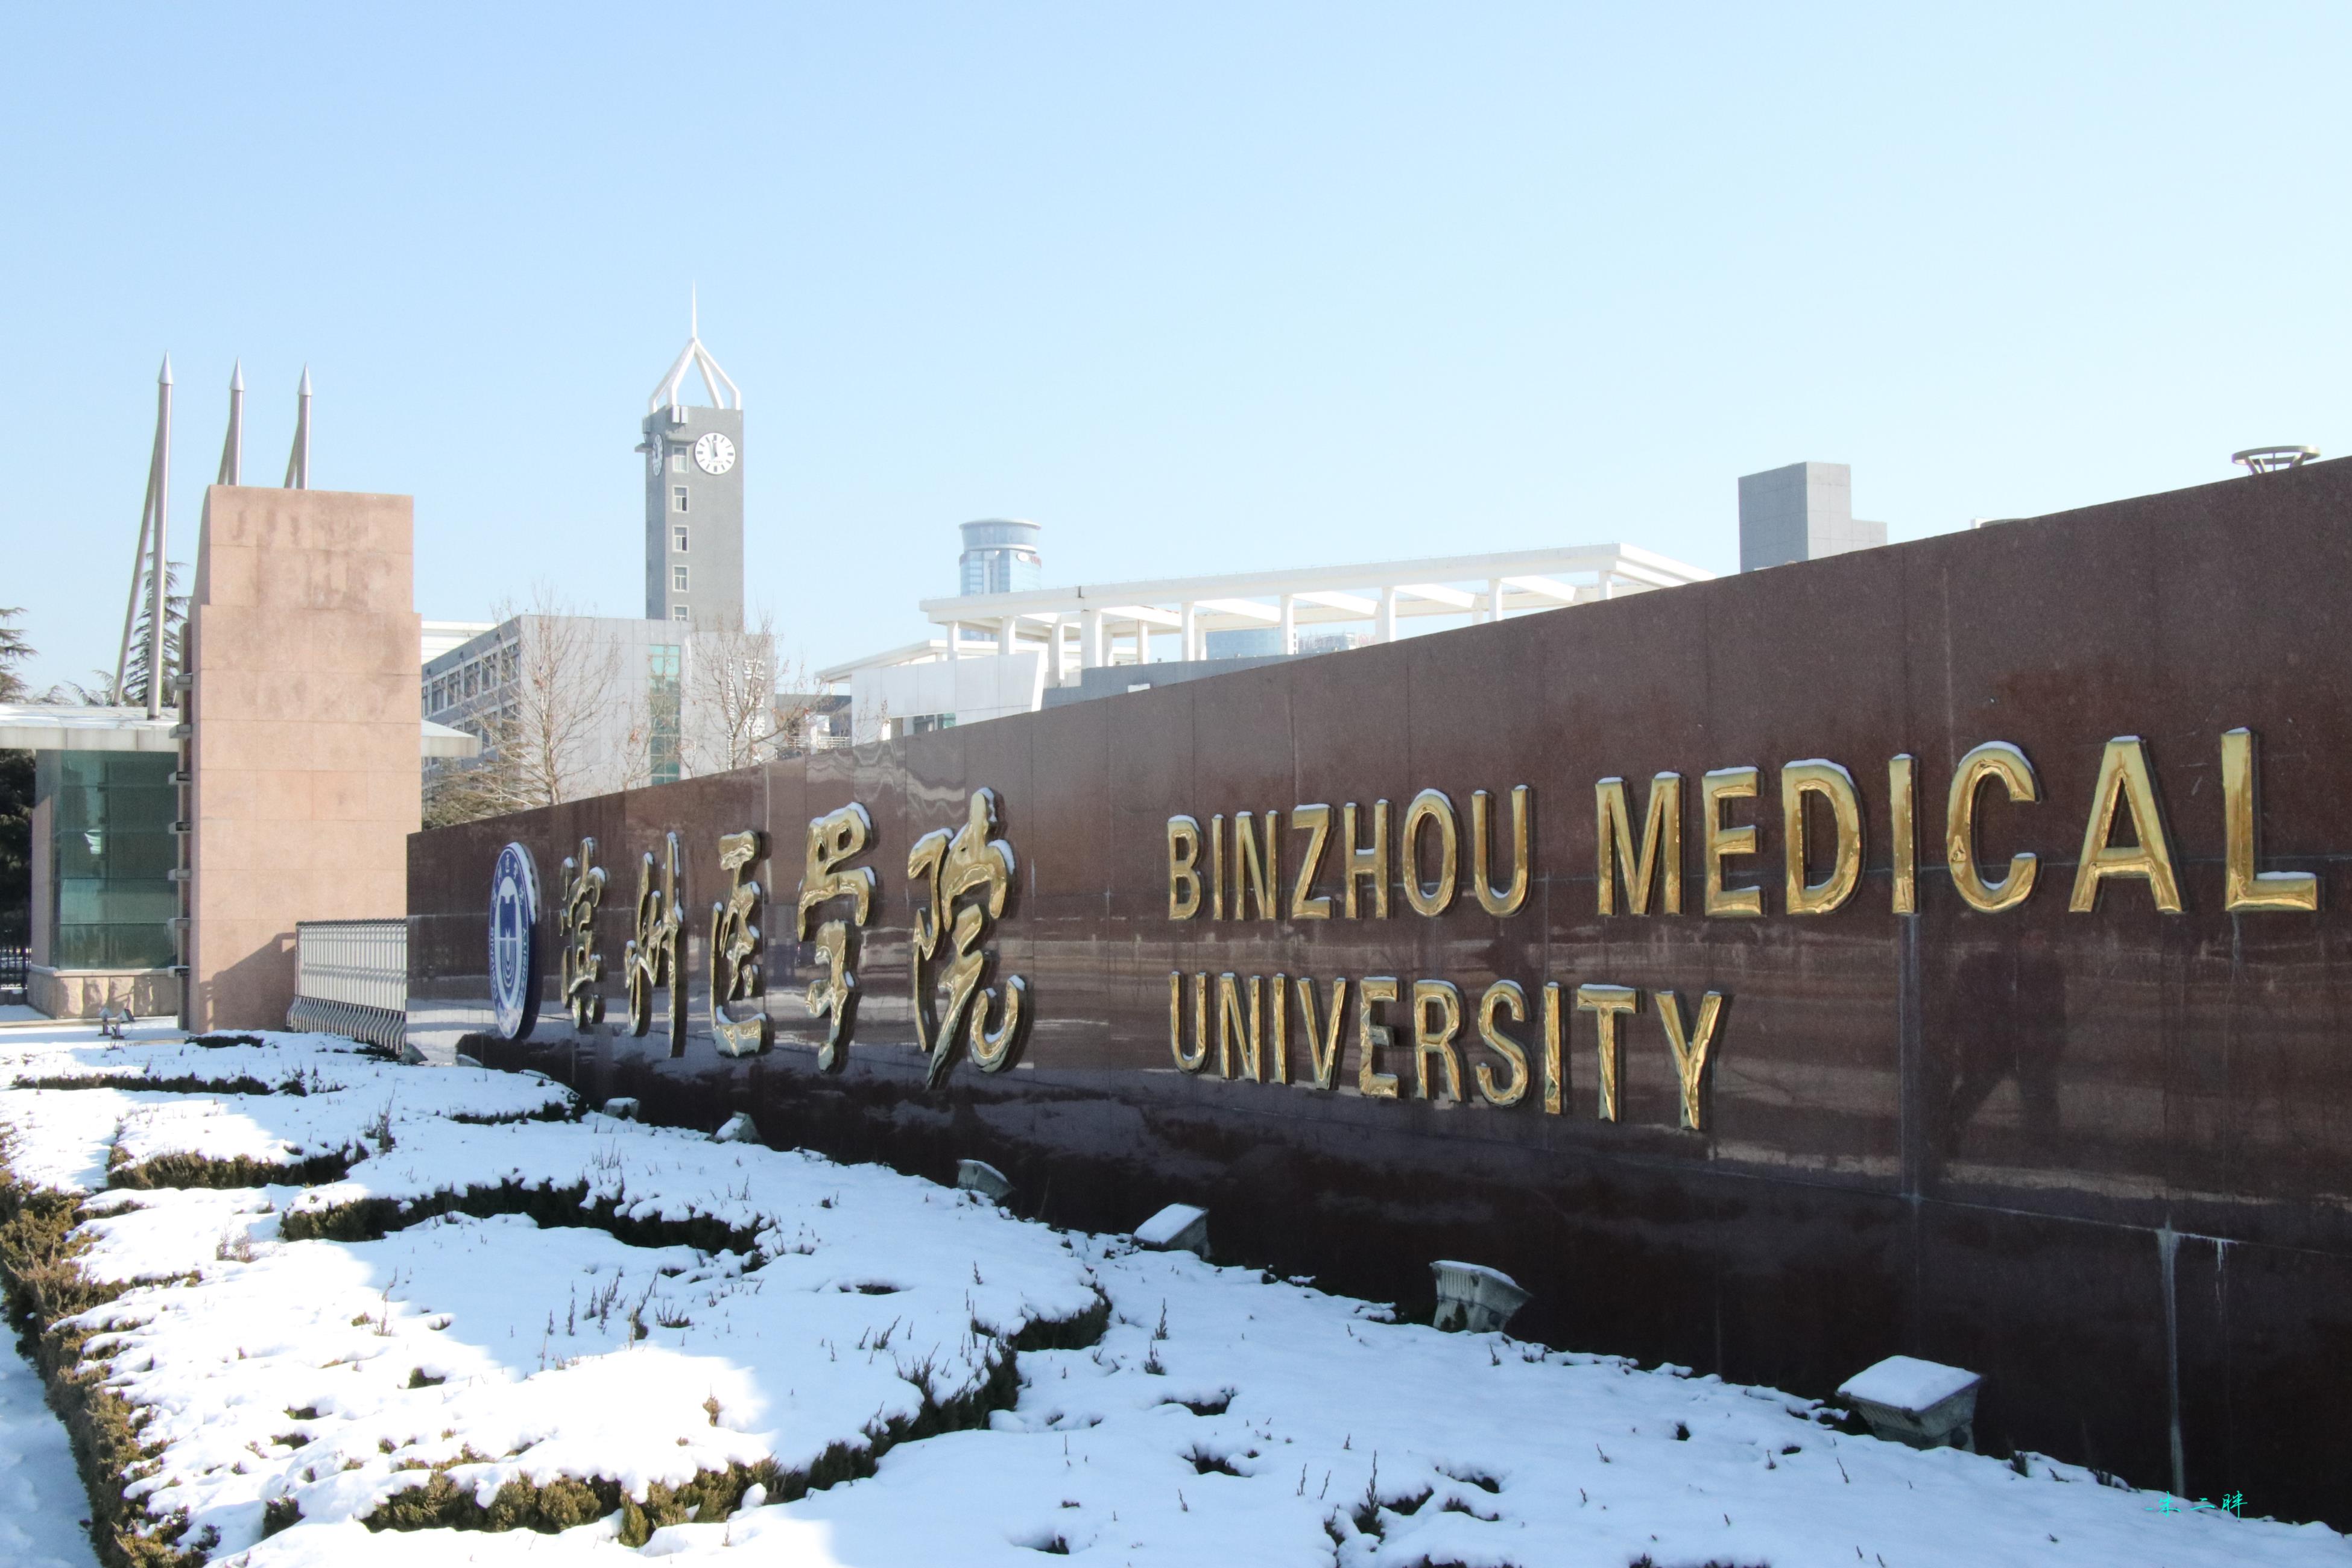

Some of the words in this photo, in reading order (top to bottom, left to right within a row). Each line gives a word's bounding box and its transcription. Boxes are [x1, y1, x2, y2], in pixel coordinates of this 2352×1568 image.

[1168, 785, 1532, 920] BINZHOU
[1595, 727, 2319, 916] MEDICAL
[1169, 970, 1724, 1131] UNIVERSITY
